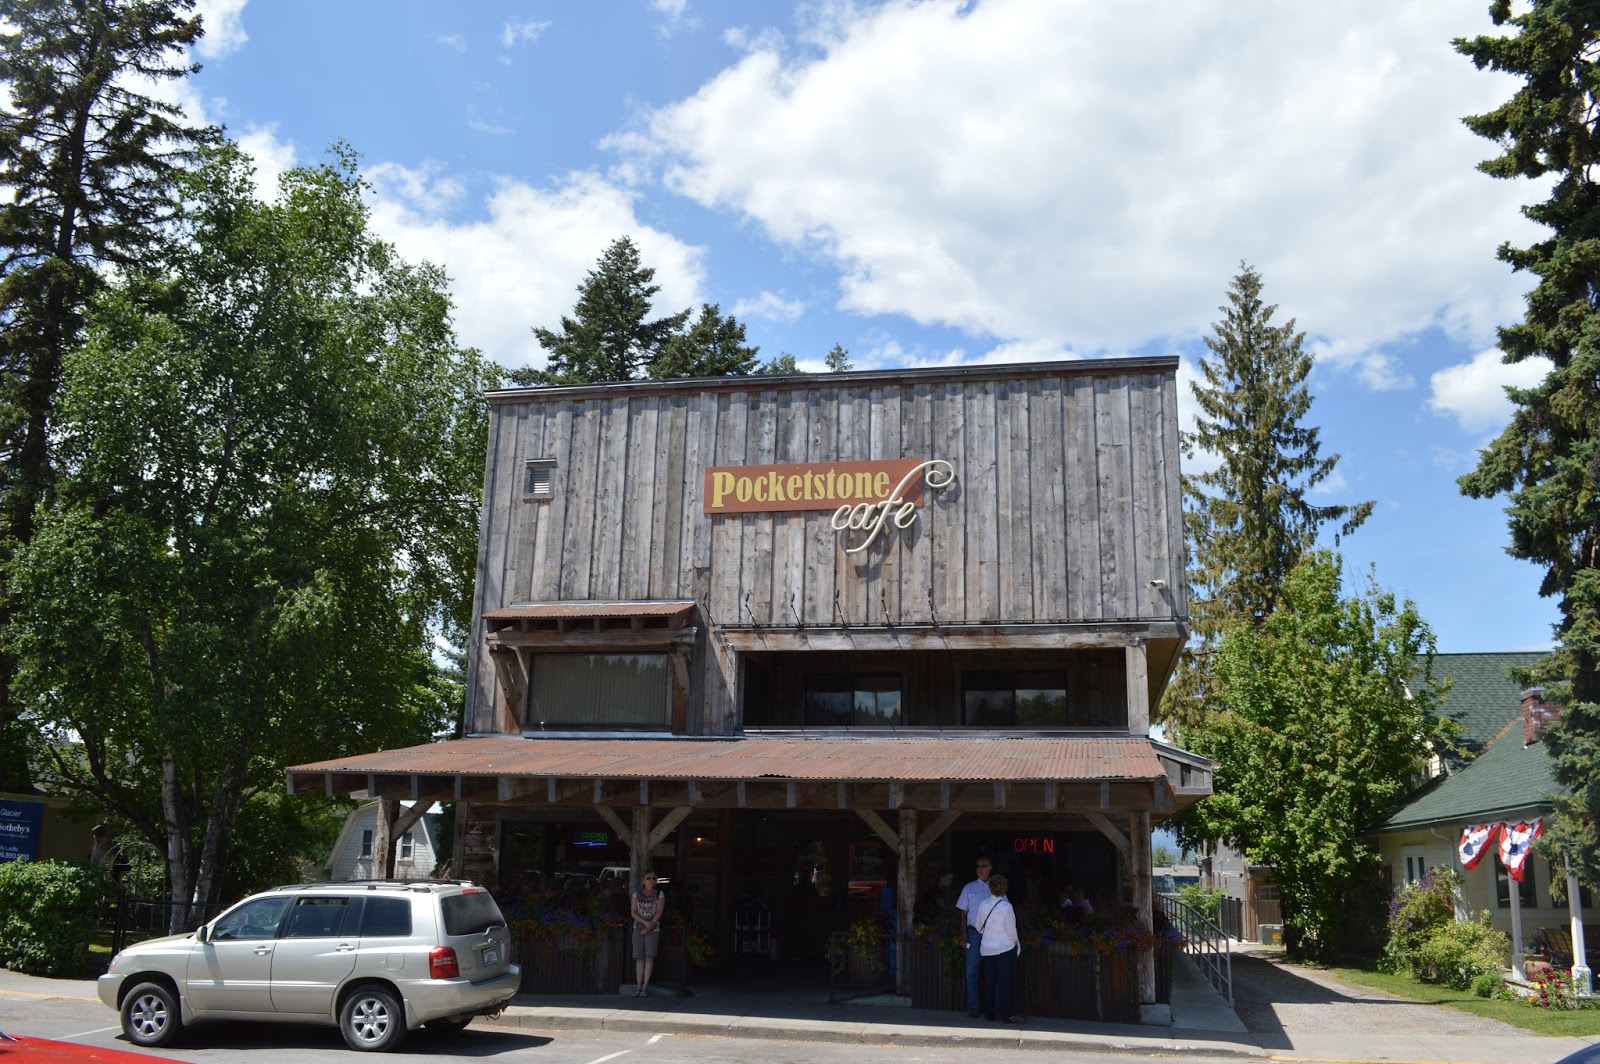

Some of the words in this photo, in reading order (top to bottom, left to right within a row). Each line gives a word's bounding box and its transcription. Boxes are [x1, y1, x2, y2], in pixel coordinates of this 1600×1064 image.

[711, 467, 890, 508] Pocketstone
[831, 459, 954, 553] cafe
[0, 808, 21, 817] Glacier
[0, 823, 30, 834] Sotheby's
[575, 832, 608, 842] SPRESSO
[1013, 838, 1054, 853] OPEN
